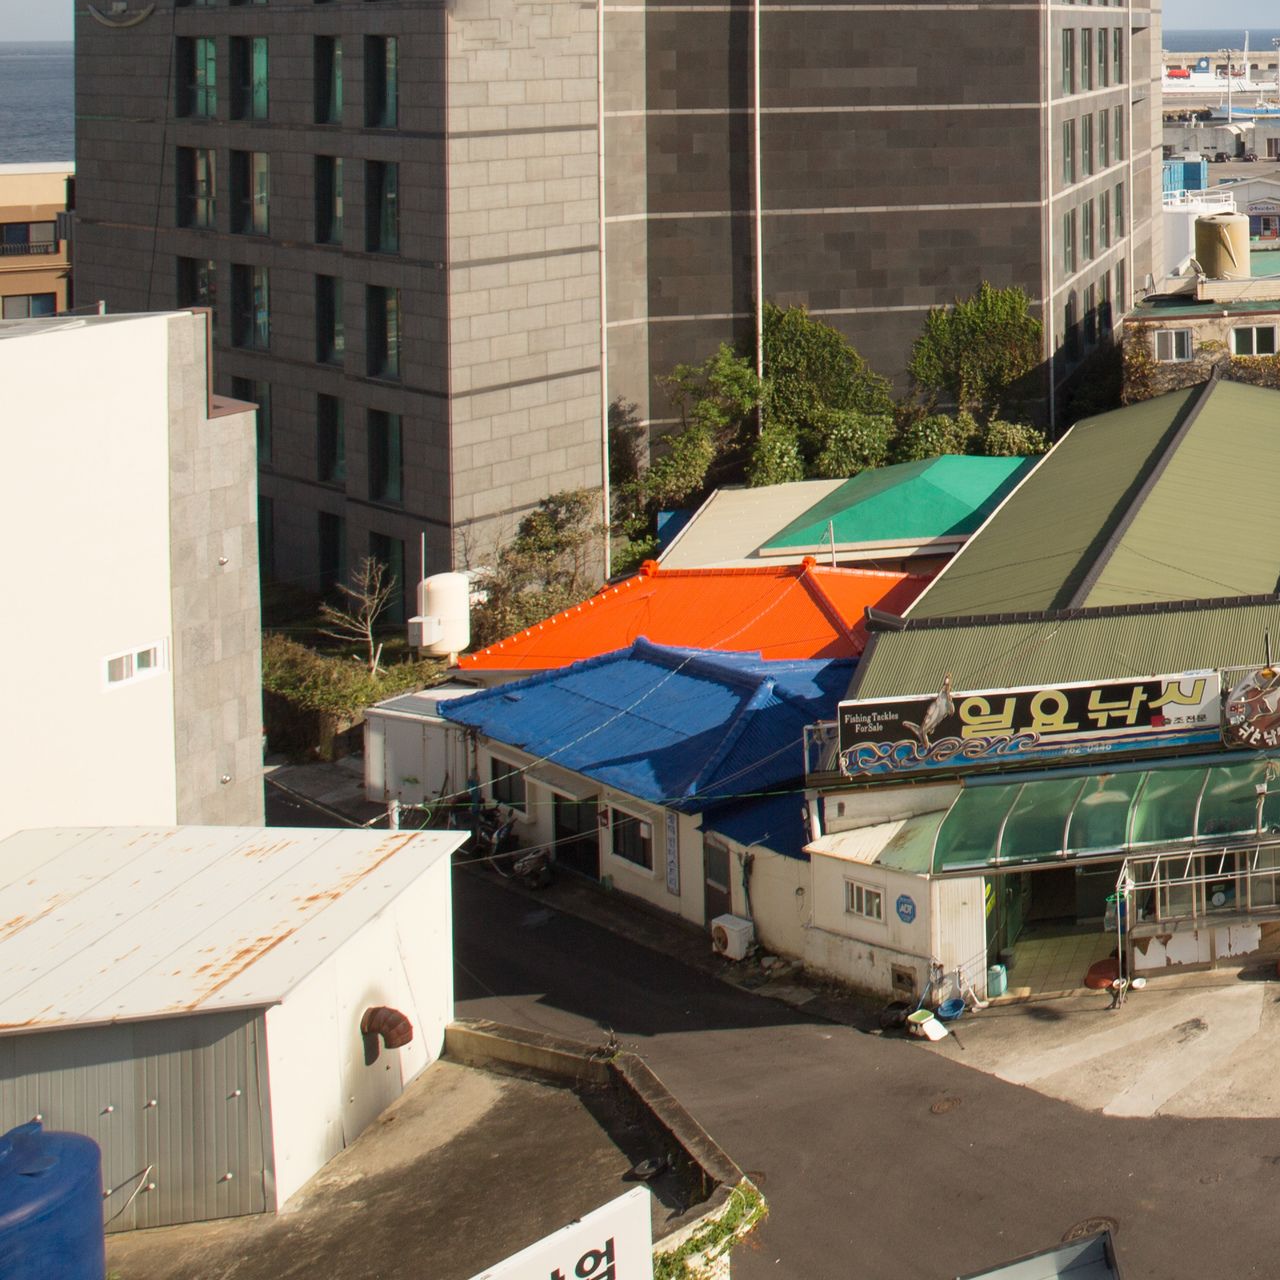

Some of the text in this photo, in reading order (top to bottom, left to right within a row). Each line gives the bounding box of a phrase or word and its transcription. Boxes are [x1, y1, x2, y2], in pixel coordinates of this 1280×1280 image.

[844, 711, 899, 725] Fishing Tackles
[959, 678, 1207, 741] 일요낚시
